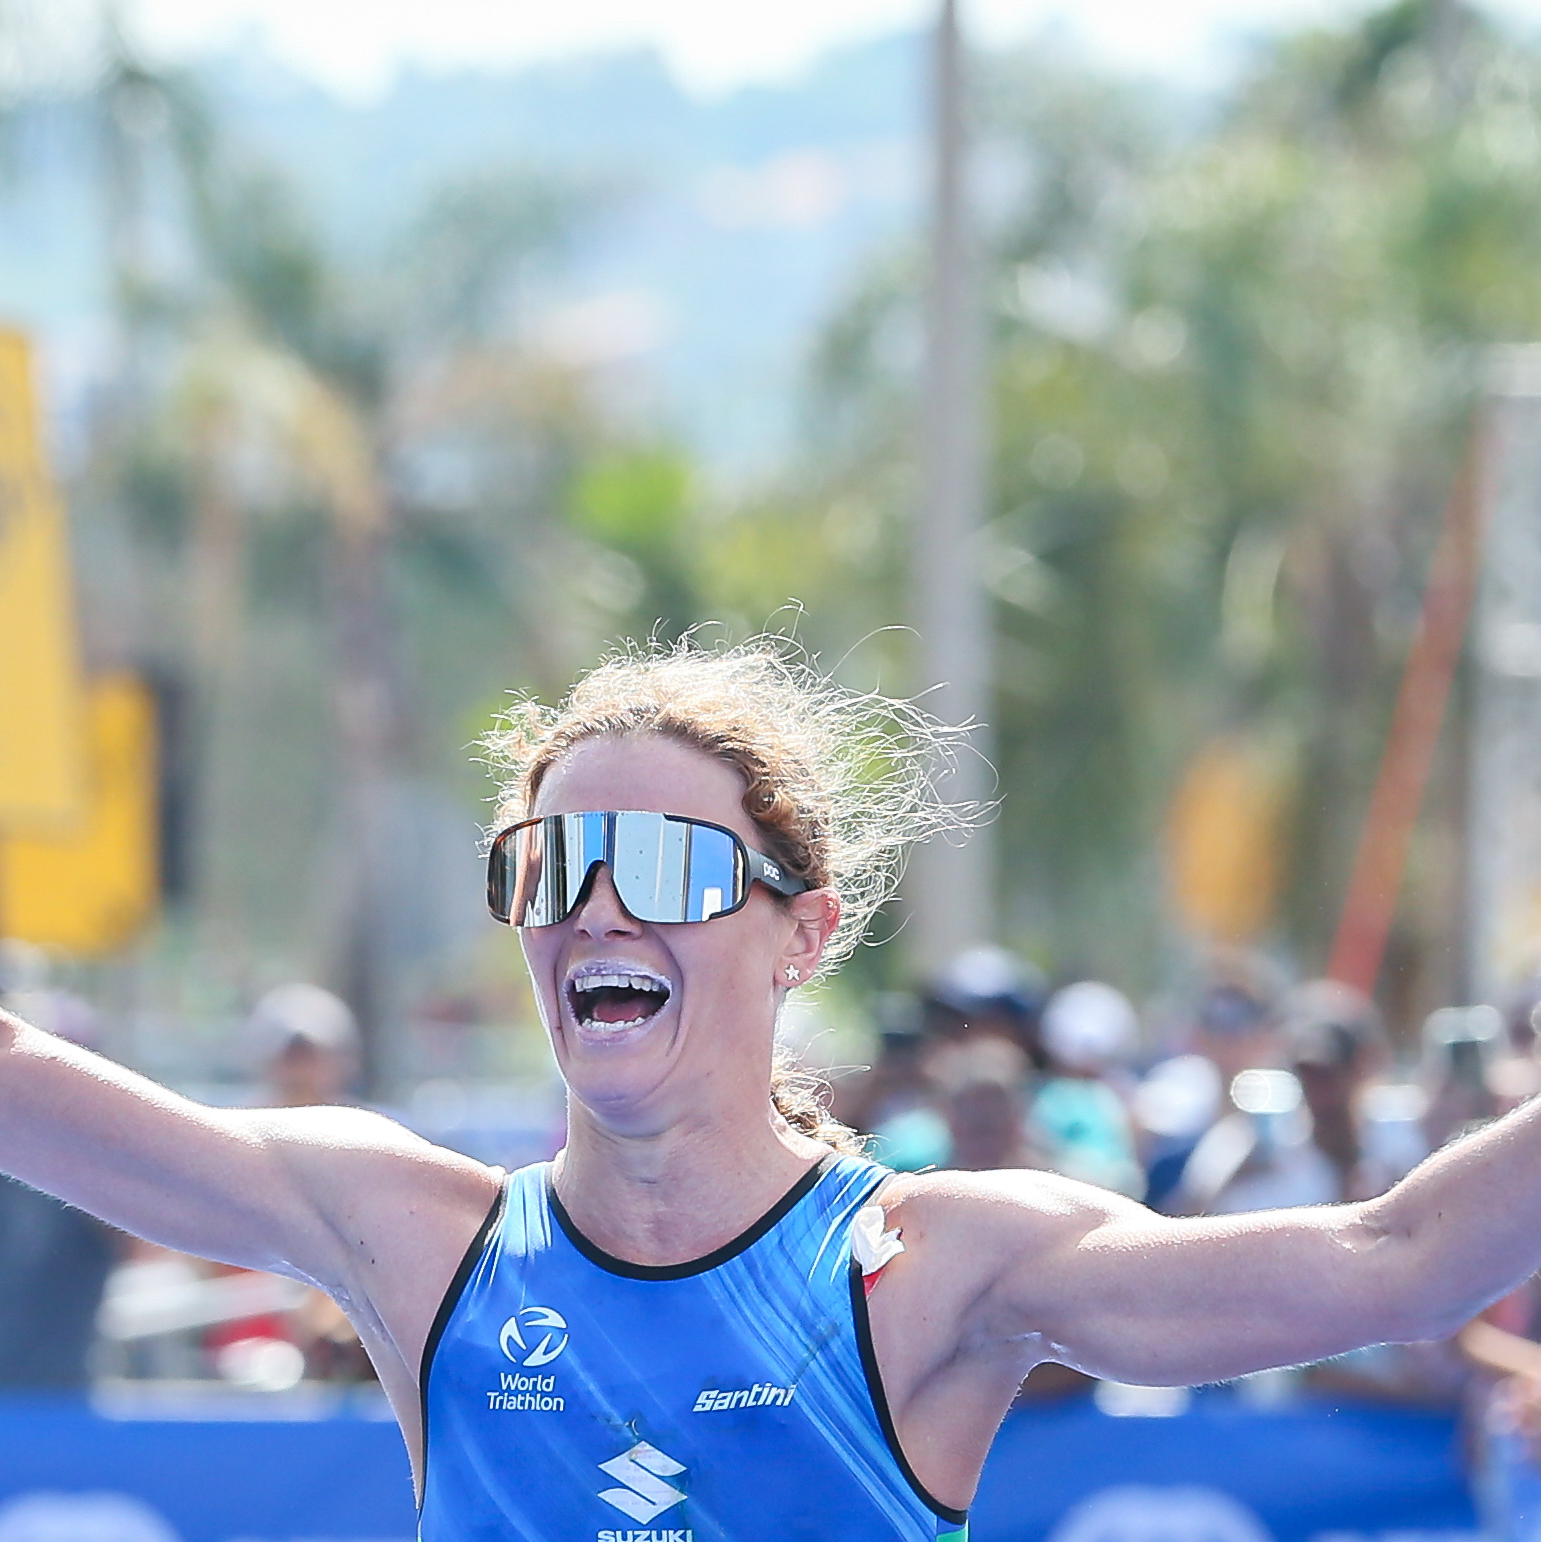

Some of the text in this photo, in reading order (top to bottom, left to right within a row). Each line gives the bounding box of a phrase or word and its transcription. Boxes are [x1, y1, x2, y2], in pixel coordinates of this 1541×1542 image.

[500, 1372, 555, 1392] World
[486, 1391, 565, 1412] Triathlon
[692, 1382, 797, 1412] Santini
